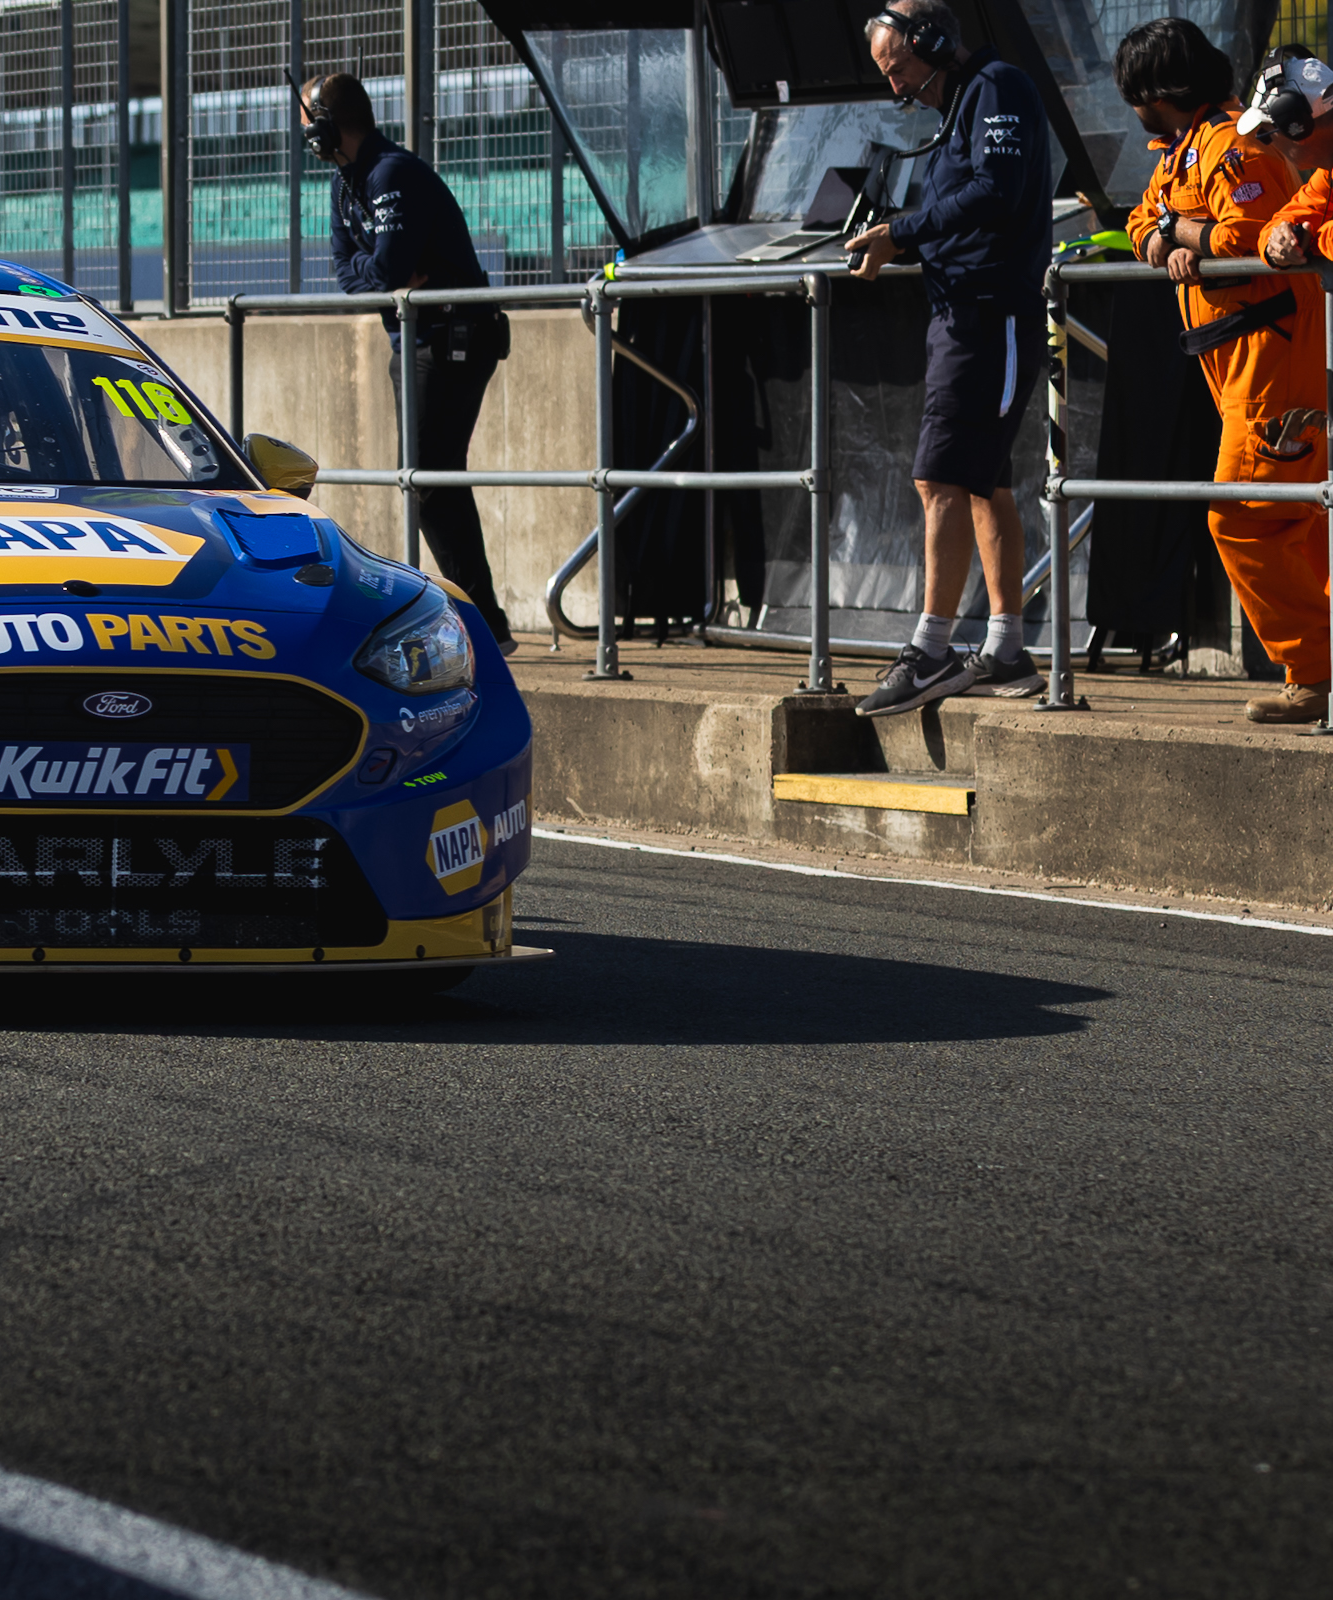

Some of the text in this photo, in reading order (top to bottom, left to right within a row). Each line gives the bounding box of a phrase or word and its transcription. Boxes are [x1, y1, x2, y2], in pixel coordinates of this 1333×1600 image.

[92, 376, 192, 425] 116
[85, 613, 276, 660] PARTS
[95, 694, 139, 715] Ford
[414, 771, 448, 786] TOW
[494, 800, 527, 846] AUTO
[435, 823, 481, 873] NAPA
